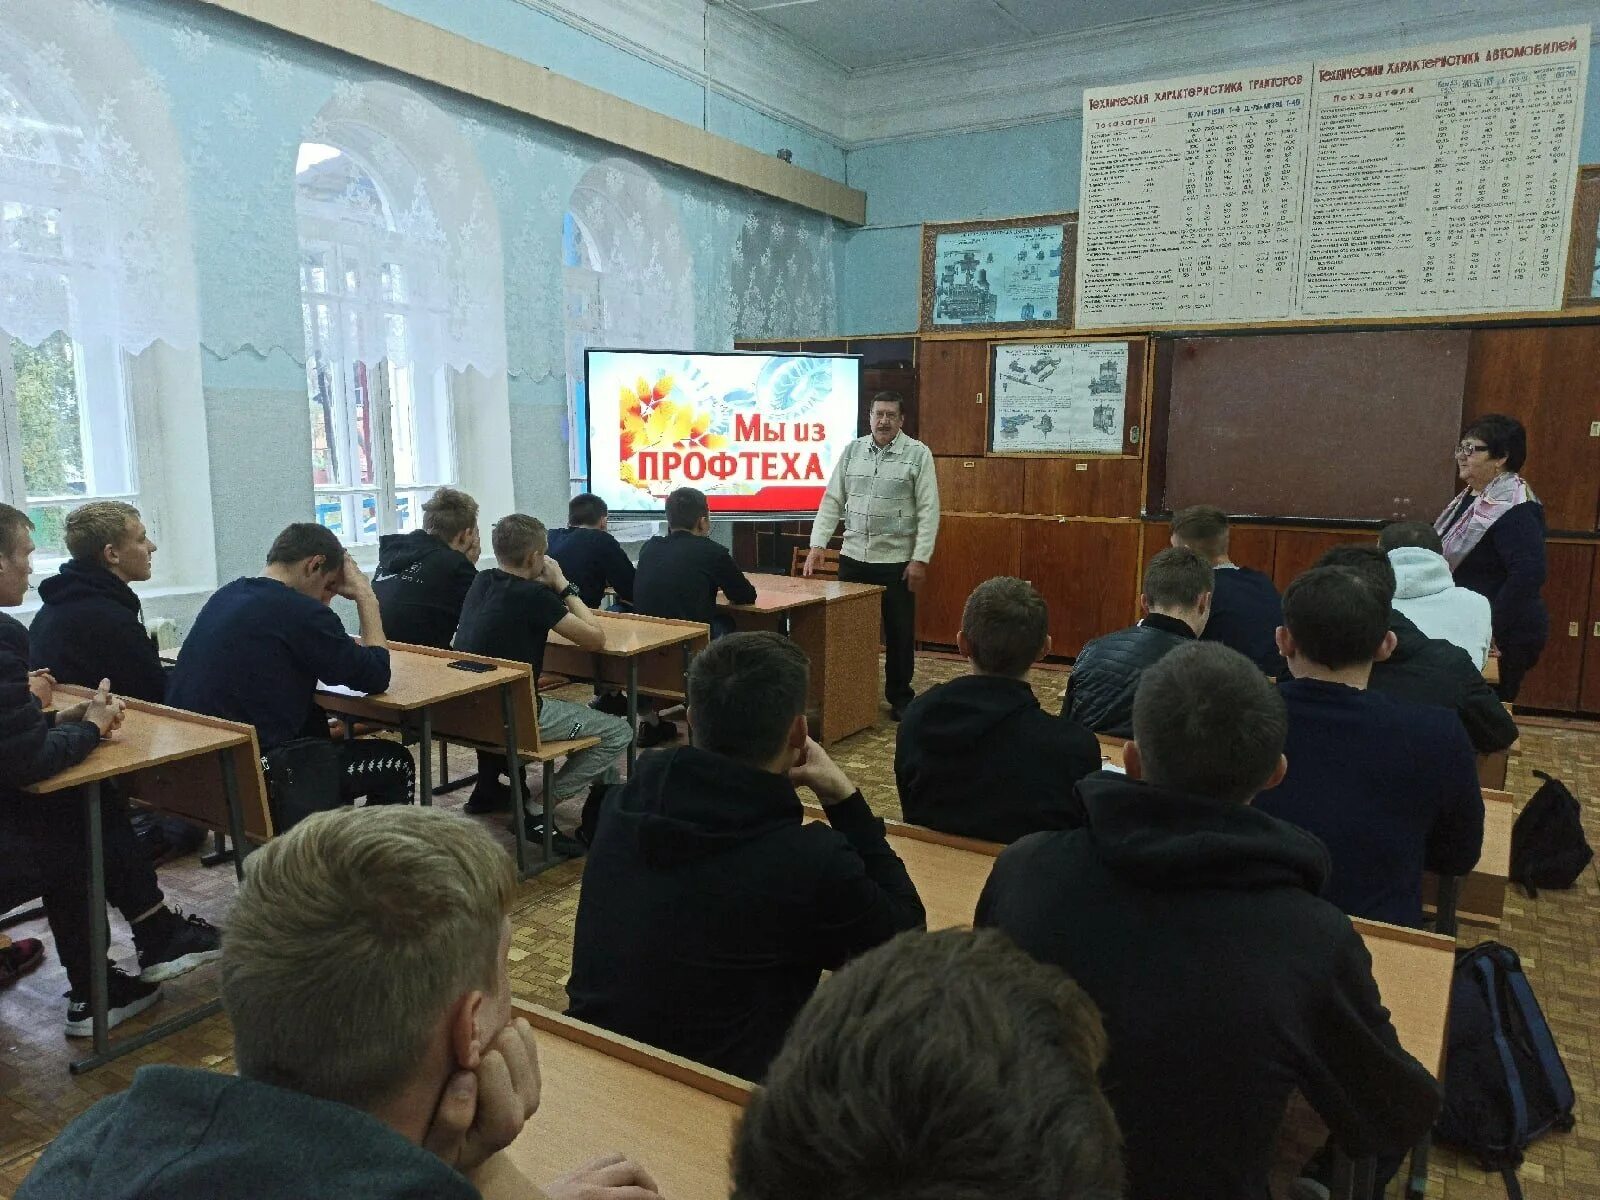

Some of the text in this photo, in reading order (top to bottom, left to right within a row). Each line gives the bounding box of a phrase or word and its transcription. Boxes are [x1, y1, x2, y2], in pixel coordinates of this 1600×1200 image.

[734, 413, 826, 442] Мы из
[638, 451, 825, 481] ПРОФТЕХА
